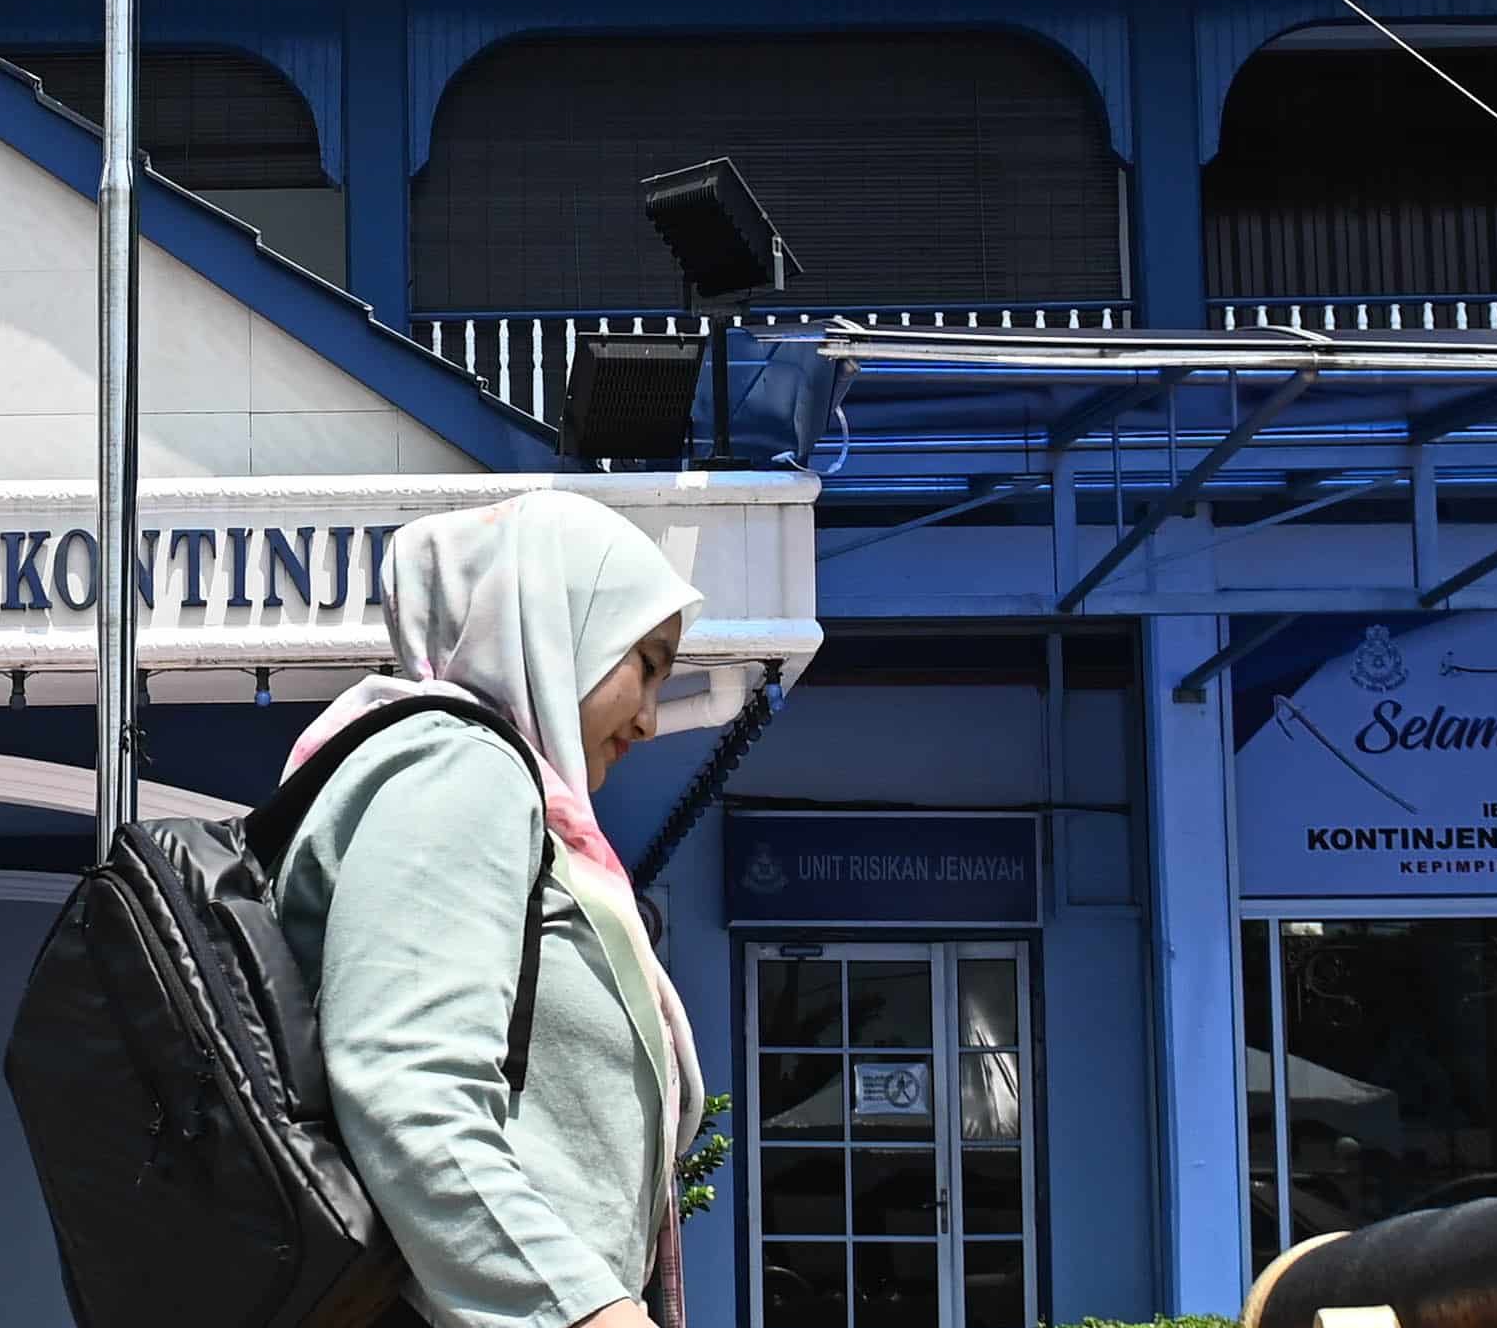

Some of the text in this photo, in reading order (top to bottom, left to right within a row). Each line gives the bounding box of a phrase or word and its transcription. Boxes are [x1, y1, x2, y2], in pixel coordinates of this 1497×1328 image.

[798, 855, 1026, 881] UNIT RISIKAN JENAYAH
